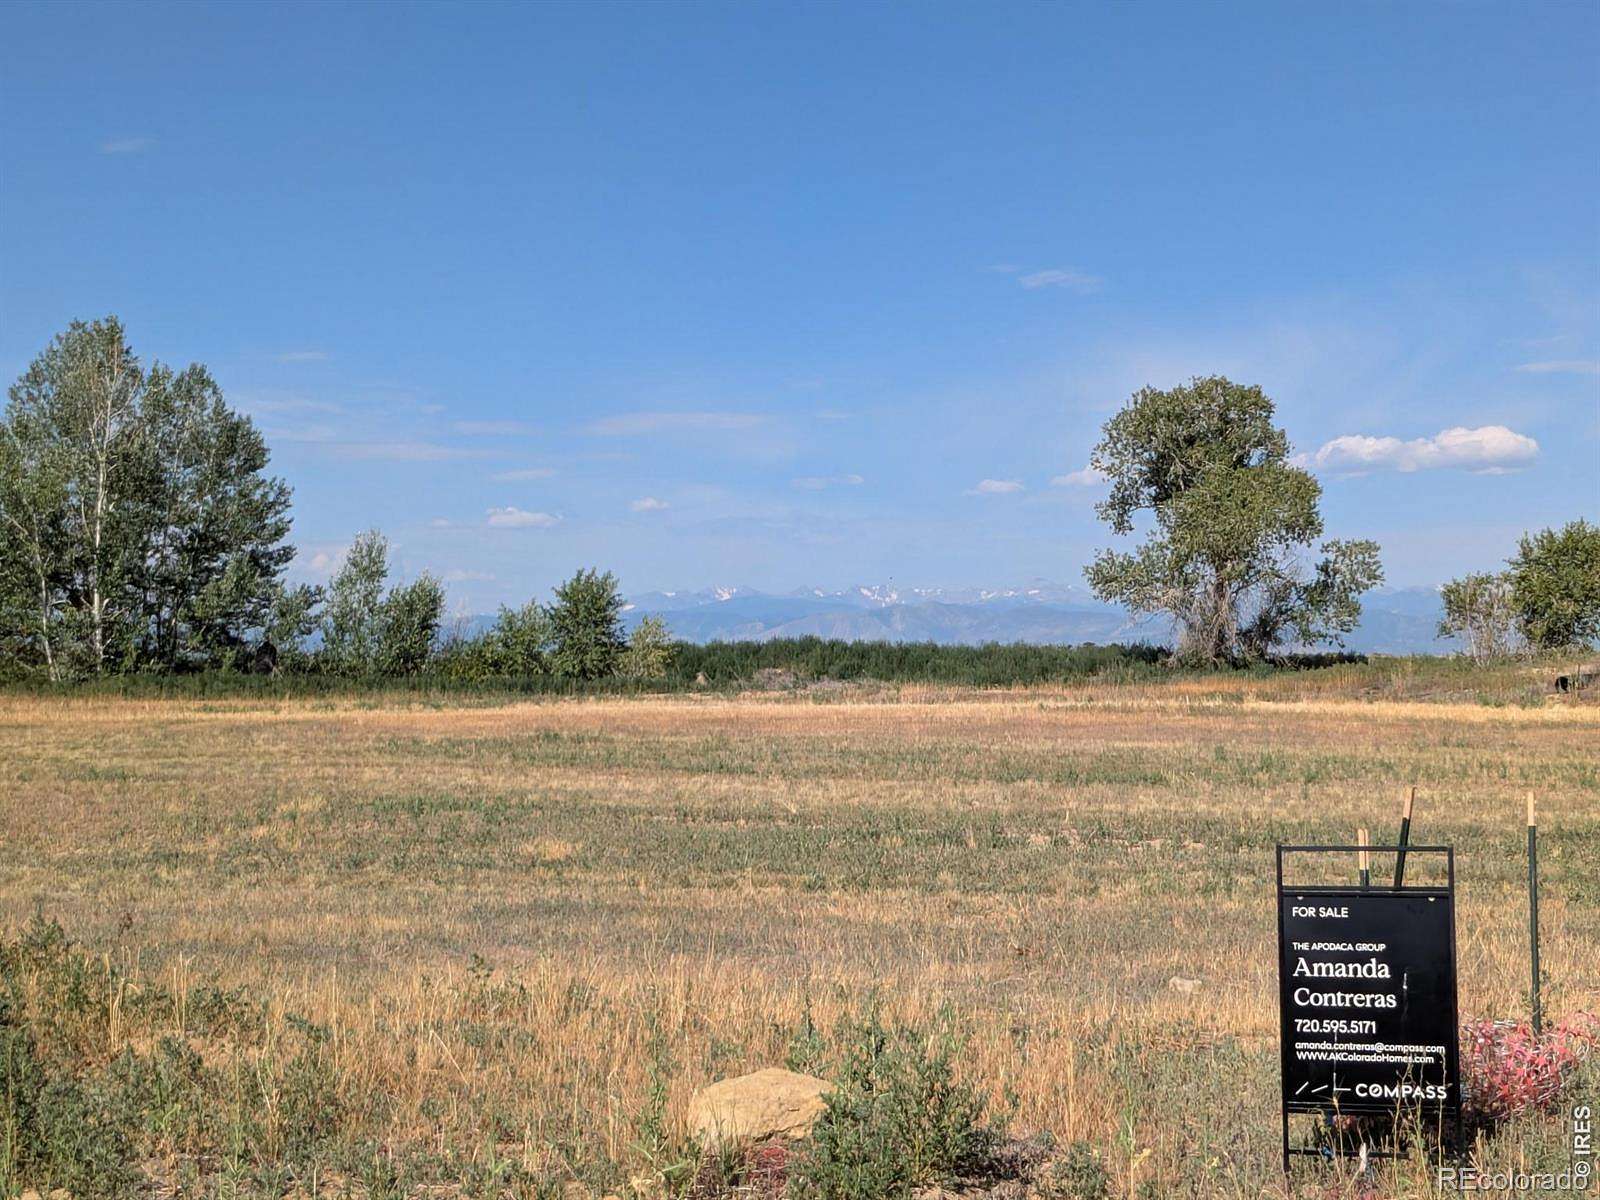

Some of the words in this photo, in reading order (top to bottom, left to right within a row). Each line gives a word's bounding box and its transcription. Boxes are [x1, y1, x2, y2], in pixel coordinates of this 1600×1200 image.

[1292, 906, 1316, 918] FOR
[1318, 907, 1349, 918] SALE
[1292, 942, 1310, 951] THE
[1311, 942, 1354, 952] APODACA
[1355, 943, 1386, 952] GROUP
[1292, 957, 1391, 979] Amanda
[1293, 987, 1397, 1009] Contreras
[1294, 1019, 1376, 1034] 720.595.5171
[1355, 1083, 1447, 1099] COMPASS
